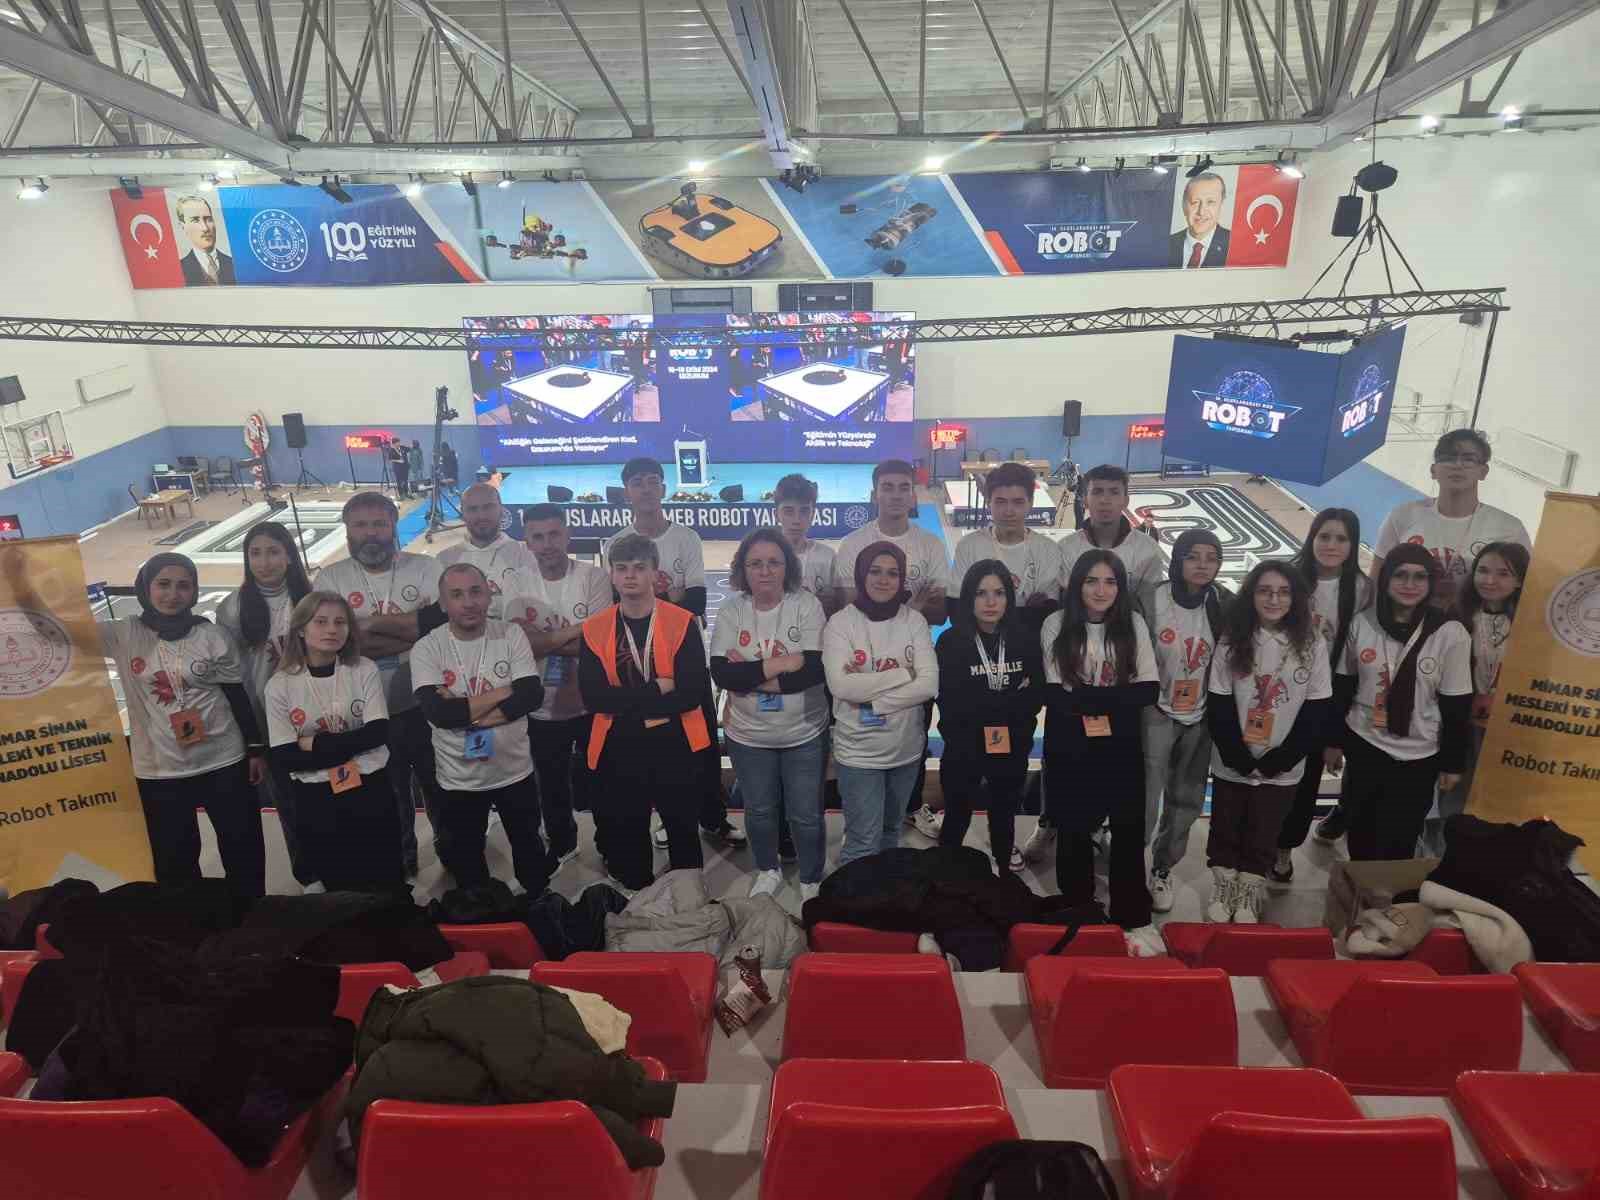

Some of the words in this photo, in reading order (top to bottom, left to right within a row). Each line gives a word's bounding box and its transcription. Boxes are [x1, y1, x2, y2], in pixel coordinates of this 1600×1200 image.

[320, 222, 366, 262] 100
[367, 224, 417, 237] EĞİTİMİN
[1037, 230, 1122, 254] ROBOT
[370, 238, 416, 249] YÜZYILI
[1202, 400, 1286, 433] ROBOT
[698, 507, 750, 527] ROBOT
[752, 507, 837, 527] YAASI
[1505, 693, 1569, 714] MESLEKİ
[1572, 705, 1592, 718] VE
[0, 729, 37, 746] MAR
[38, 719, 88, 738] SİNAN
[1510, 713, 1585, 735] ANADOLU
[0, 746, 33, 764] LEKİ
[34, 743, 56, 757] VE
[57, 731, 113, 752] TEKNİK
[60, 749, 106, 770] LİSESİ
[1501, 749, 1557, 775] Robot
[0, 802, 55, 826] Robot
[56, 791, 118, 812] Takımı
